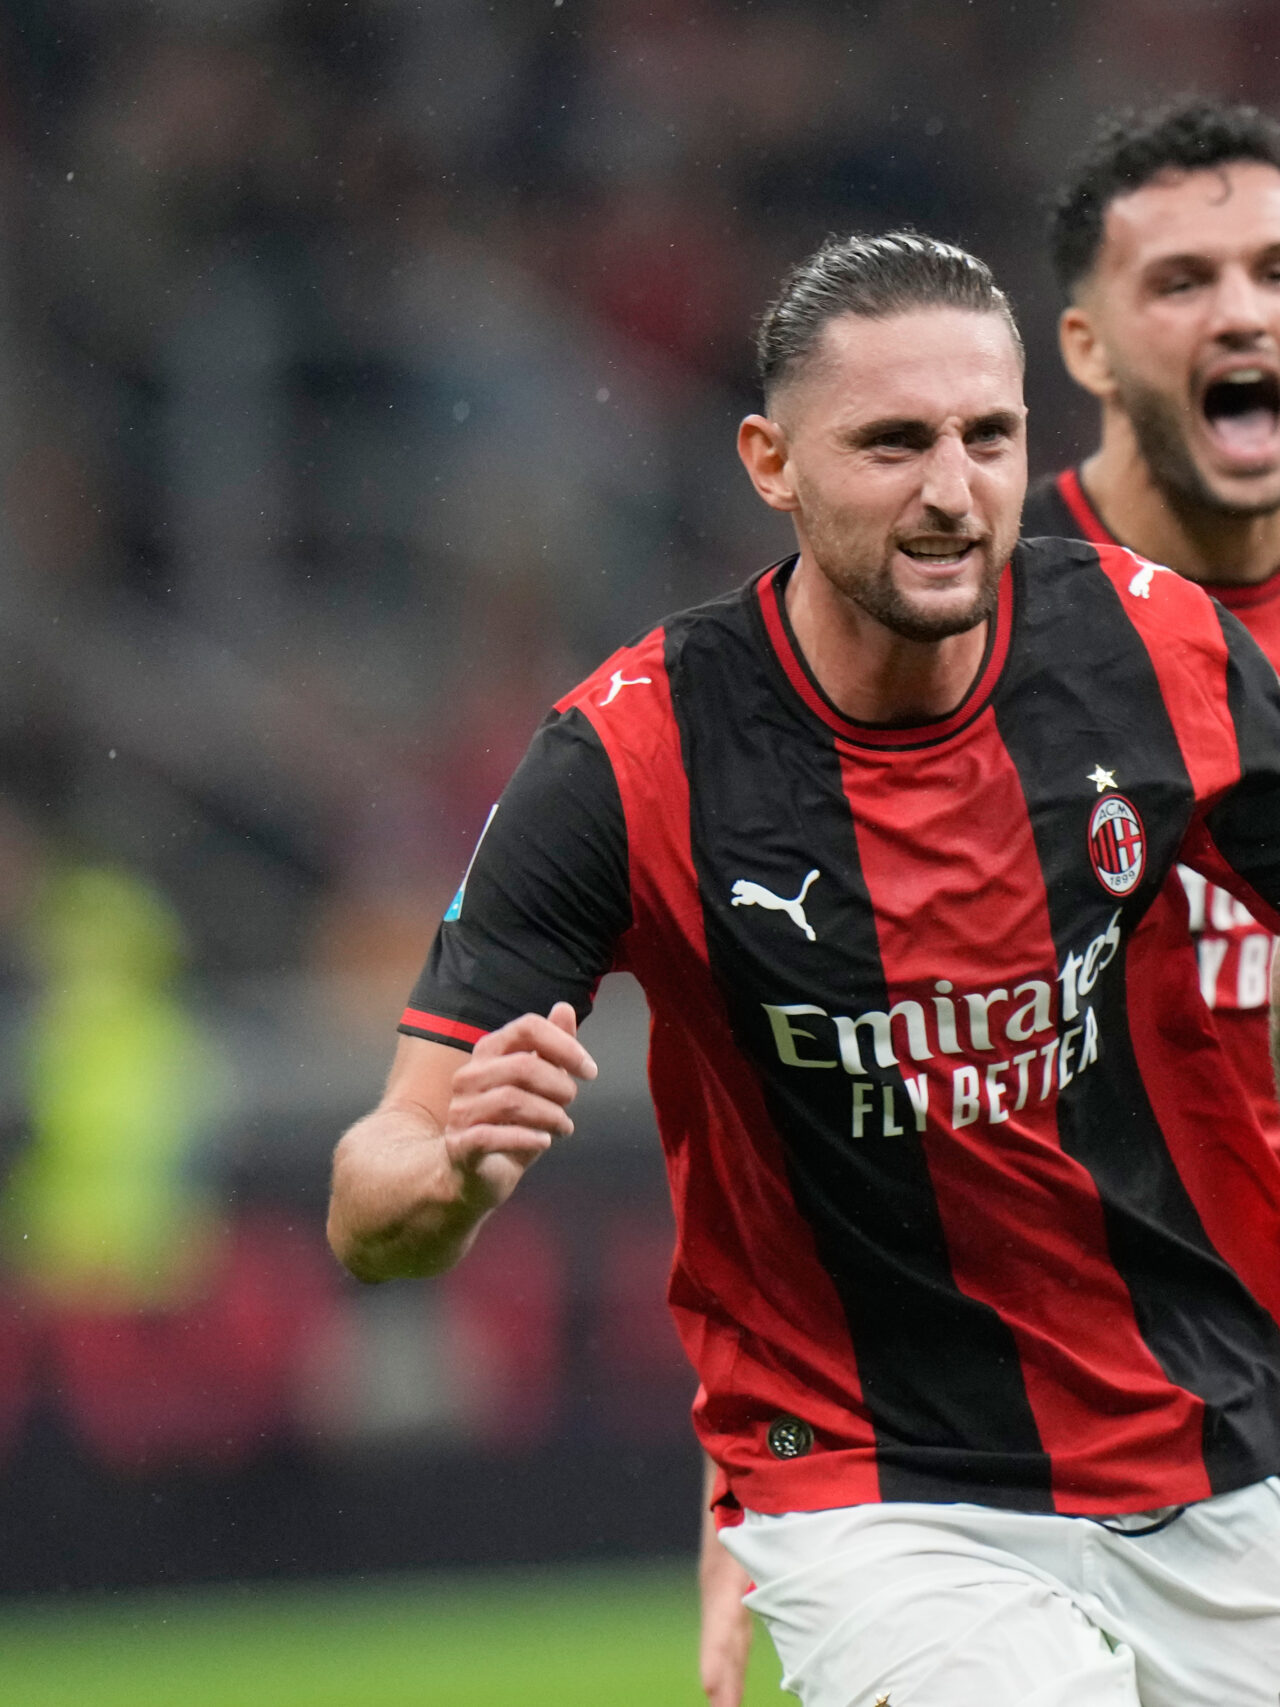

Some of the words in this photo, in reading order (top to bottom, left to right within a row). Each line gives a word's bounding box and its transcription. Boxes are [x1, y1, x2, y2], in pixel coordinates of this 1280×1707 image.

[1099, 803, 1129, 819] ACM
[1109, 870, 1136, 886] 1899
[760, 907, 1123, 1075] Emirates
[852, 1073, 929, 1138] FLY
[952, 1006, 1098, 1131] BETTER
